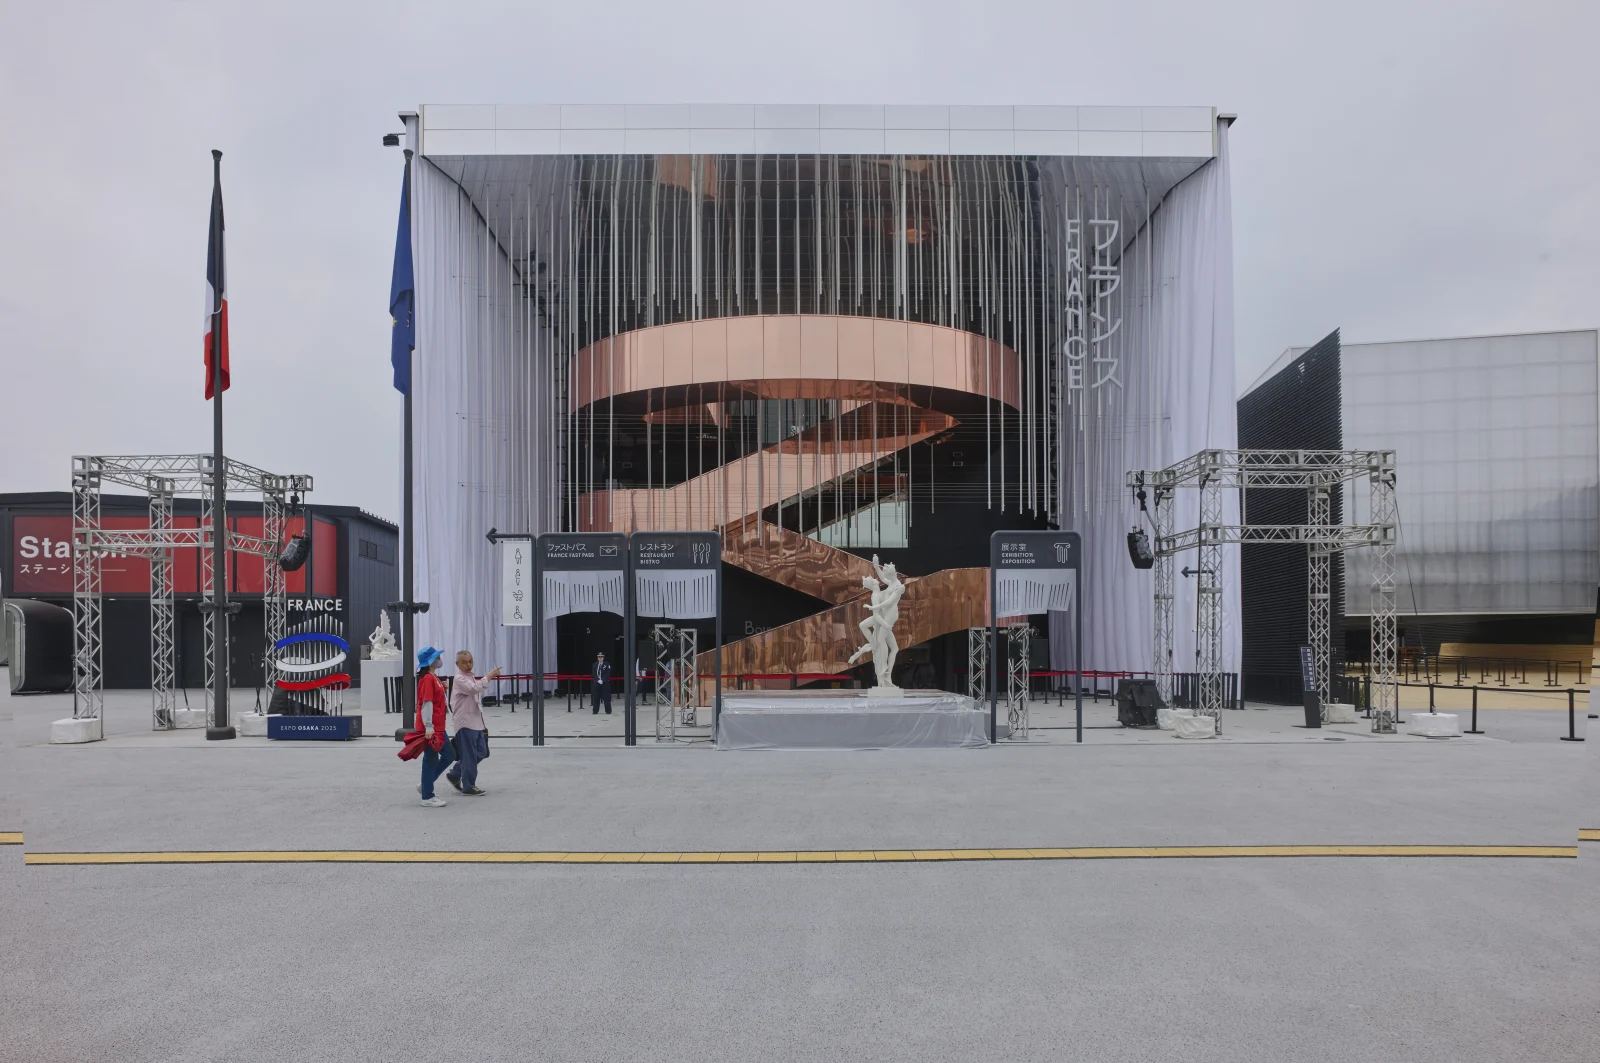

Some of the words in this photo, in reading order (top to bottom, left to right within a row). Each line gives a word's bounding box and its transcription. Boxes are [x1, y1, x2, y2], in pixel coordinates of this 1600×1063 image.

[1063, 219, 1088, 389] FRANCE
[1088, 218, 1123, 390] フランス
[20, 535, 127, 558] Staton
[547, 543, 587, 551] ファストパス
[640, 543, 674, 551] レストラン
[1001, 543, 1027, 551] 展示室
[287, 599, 343, 611] FRANCE
